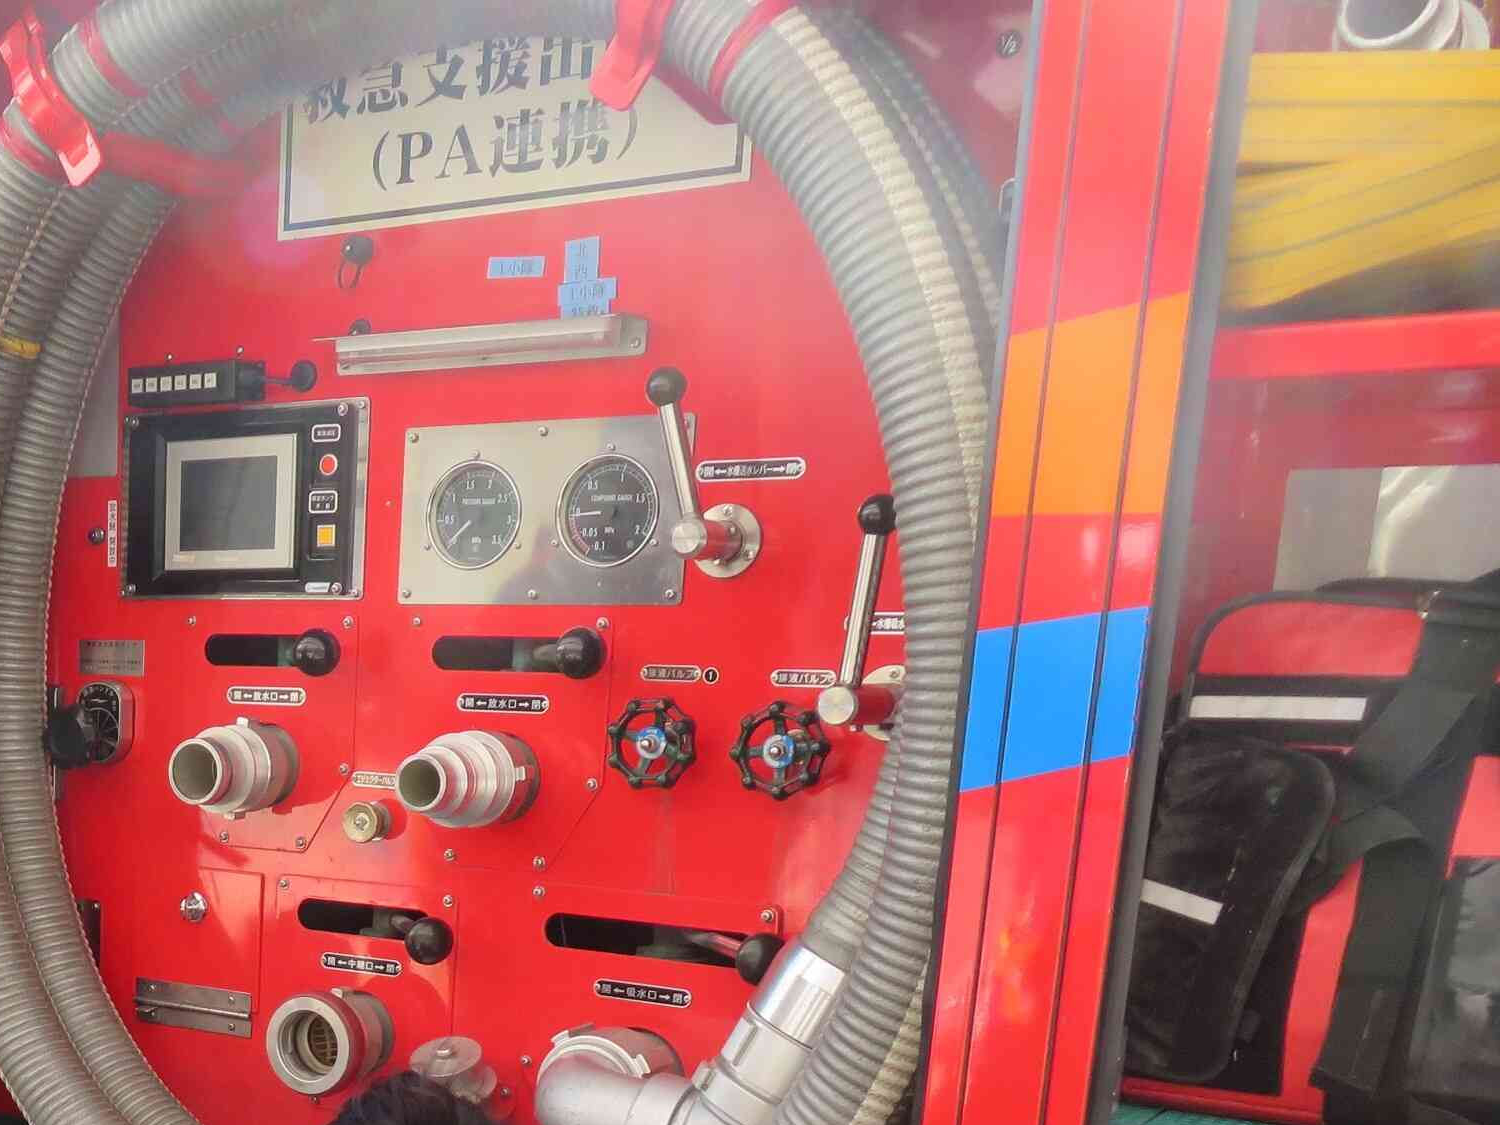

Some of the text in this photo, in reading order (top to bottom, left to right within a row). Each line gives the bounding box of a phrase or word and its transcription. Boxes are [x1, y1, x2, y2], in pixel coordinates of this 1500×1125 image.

[487, 698, 517, 709] 放水口
[627, 987, 657, 999] 吸水口
